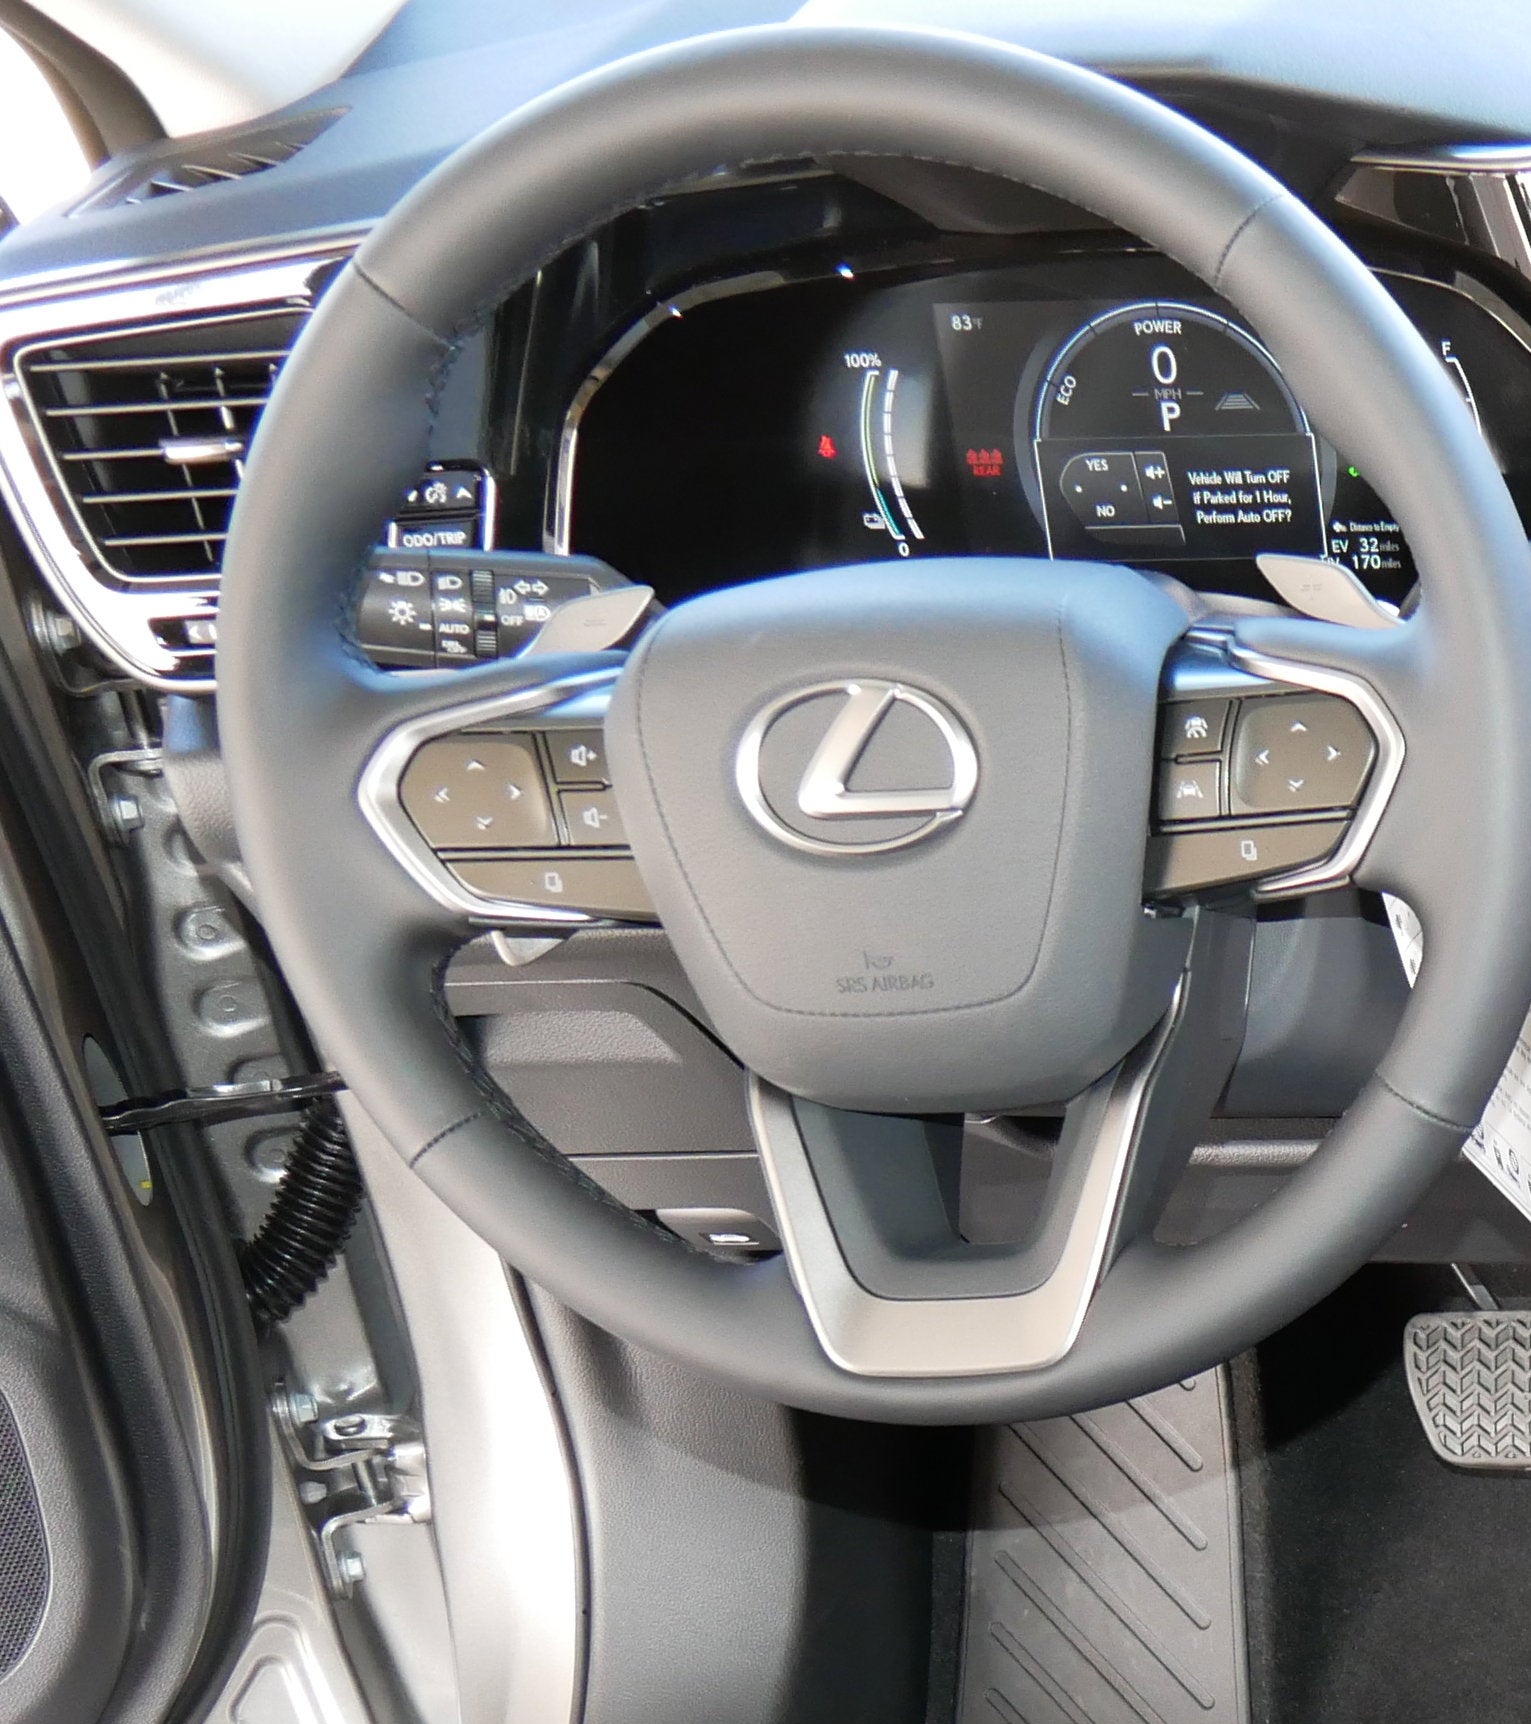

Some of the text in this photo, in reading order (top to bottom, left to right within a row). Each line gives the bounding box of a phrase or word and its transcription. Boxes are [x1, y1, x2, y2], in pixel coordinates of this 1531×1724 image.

[1133, 320, 1182, 335] POWER
[1442, 340, 1451, 356] F
[844, 353, 882, 368] 100%
[1152, 346, 1177, 384] 0
[1056, 375, 1077, 406] ECO
[1154, 388, 1182, 400] MPH
[1161, 401, 1181, 432] P
[973, 465, 1001, 477] REAR
[1084, 459, 1110, 471] YES
[1188, 469, 1290, 485] Vehicle Will Turn OFF
[1193, 491, 1201, 504] if
[1203, 490, 1236, 504] Parked
[1239, 490, 1253, 503] for
[1263, 490, 1292, 505] Hour,
[1096, 505, 1116, 517] NO
[1196, 508, 1292, 524] Perform Auto OFF?
[403, 531, 467, 547] ODO/TRIP
[1331, 539, 1349, 553] EV
[1359, 537, 1379, 552] 32
[898, 542, 910, 557] 0
[1352, 554, 1381, 569] 170
[438, 623, 470, 634] AUTO
[501, 615, 523, 627] OFF
[836, 972, 934, 994] SRS AIRBAG
